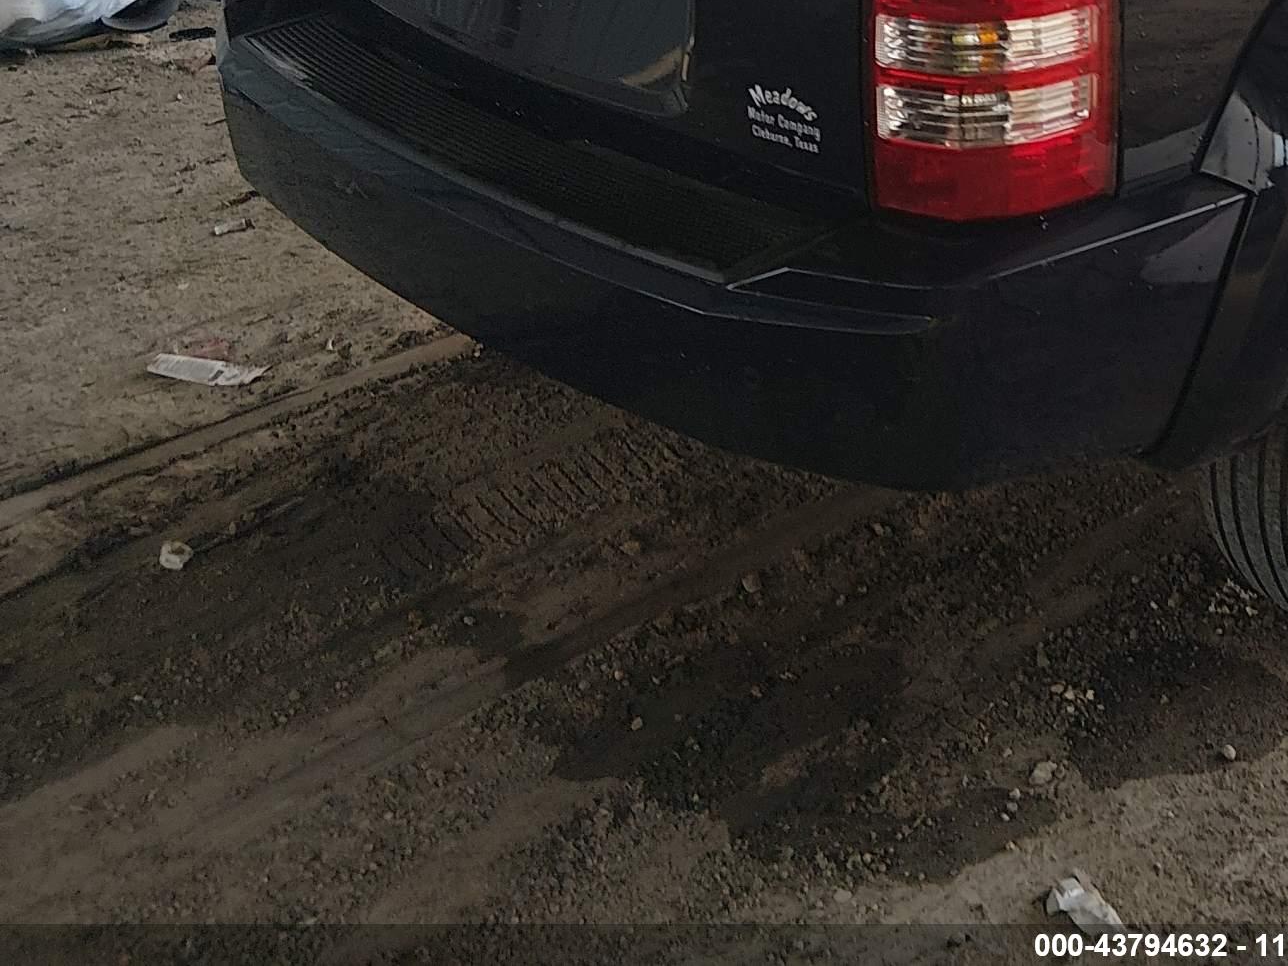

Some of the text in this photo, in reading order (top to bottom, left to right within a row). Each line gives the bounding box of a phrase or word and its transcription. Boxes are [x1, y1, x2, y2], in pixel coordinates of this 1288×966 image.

[748, 84, 818, 121] Meadows
[777, 113, 821, 142] Company
[793, 135, 819, 153] Texas
